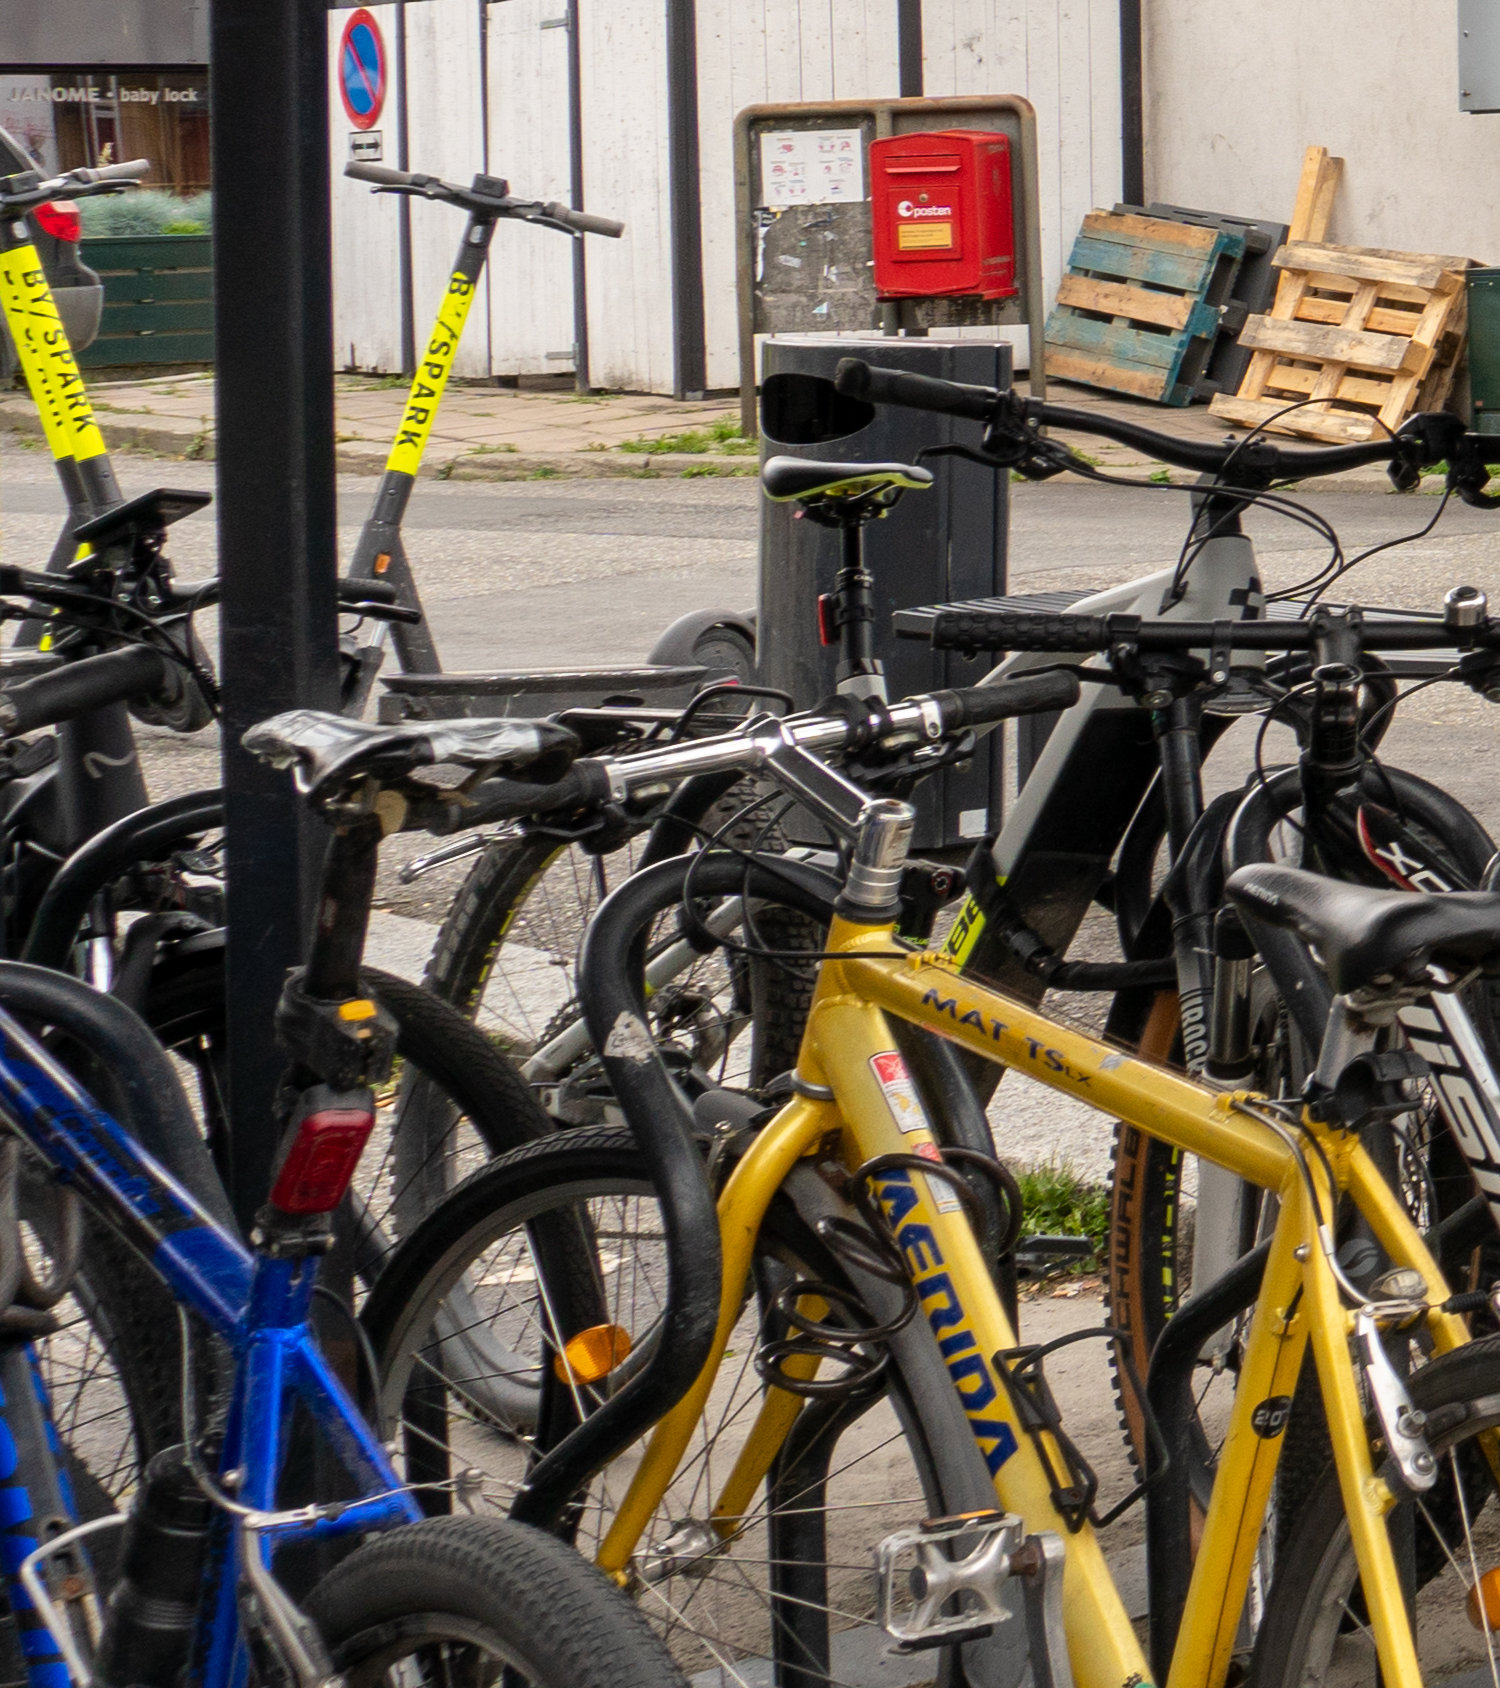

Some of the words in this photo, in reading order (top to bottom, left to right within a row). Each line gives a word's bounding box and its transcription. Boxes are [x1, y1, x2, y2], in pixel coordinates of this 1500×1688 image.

[10, 87, 100, 102] JANOME
[119, 87, 160, 105] baby
[164, 87, 200, 102] lock
[912, 205, 952, 218] posten
[22, 269, 98, 433] BY/SPARK
[1115, 1126, 1142, 1330] CHWALB
[874, 1167, 1019, 1479] MERIDA
